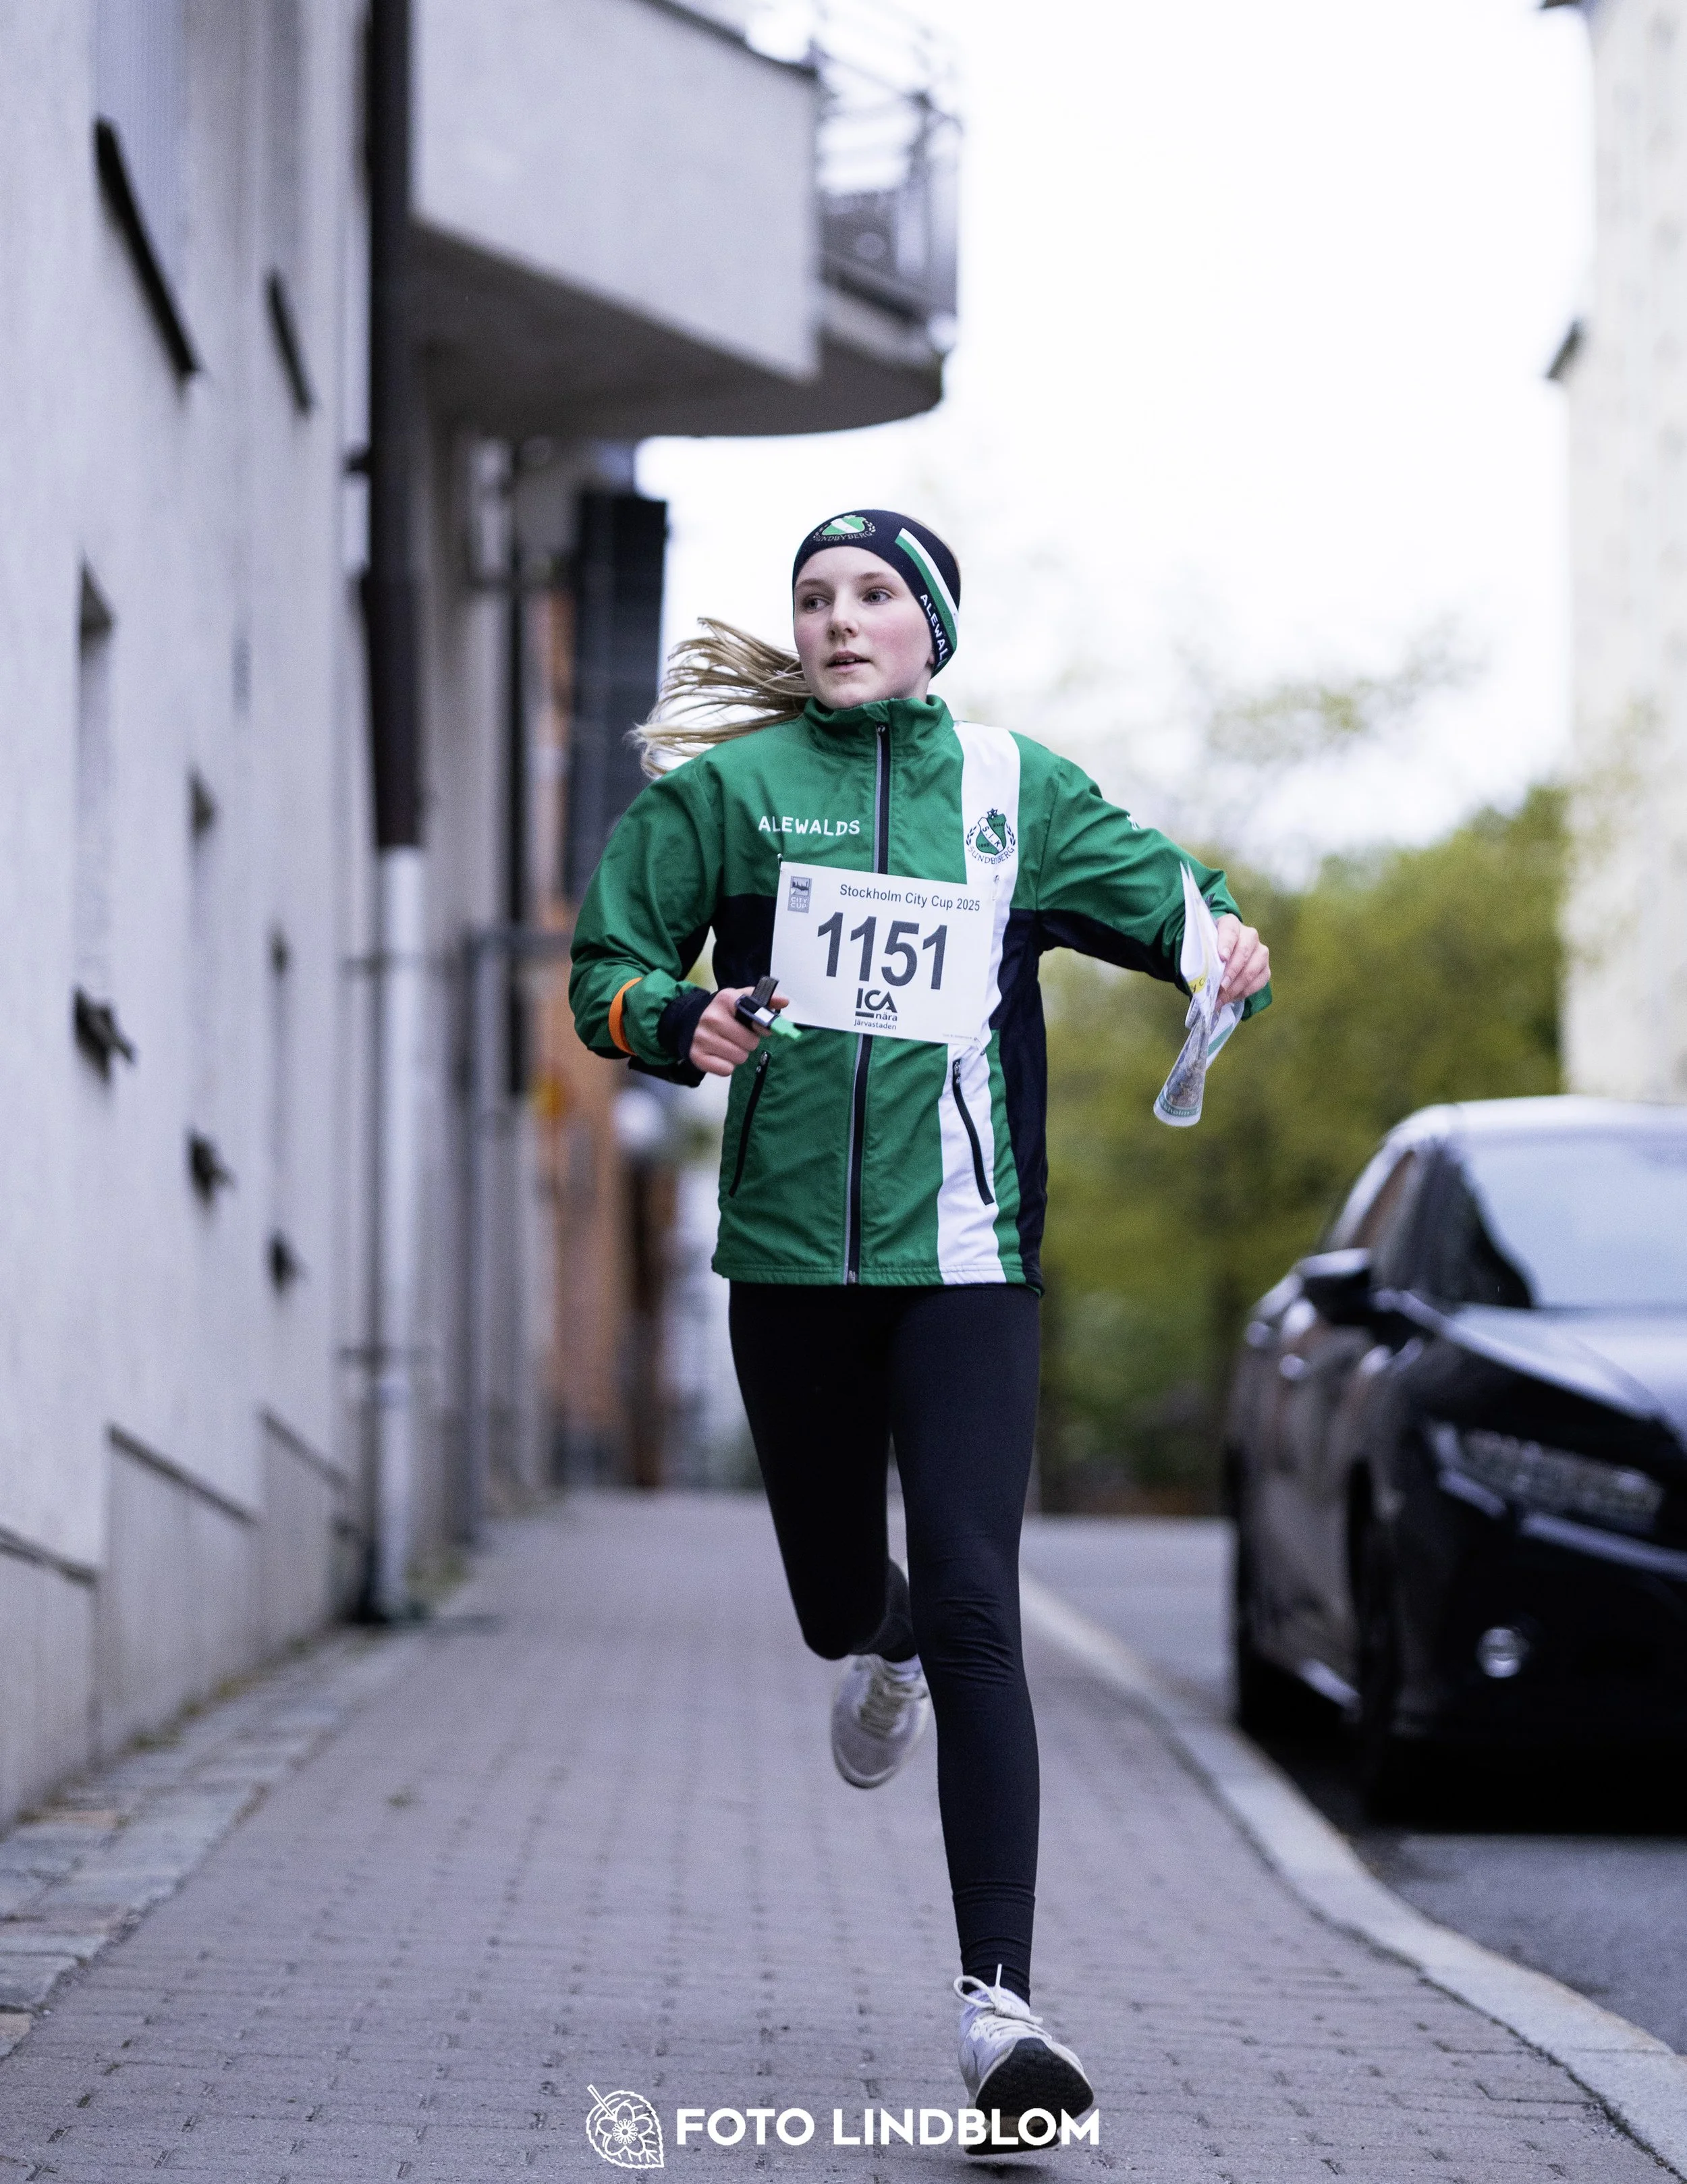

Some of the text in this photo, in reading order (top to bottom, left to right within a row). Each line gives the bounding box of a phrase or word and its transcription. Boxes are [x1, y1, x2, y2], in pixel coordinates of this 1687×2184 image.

[758, 815, 860, 836] ALEWALDS
[839, 883, 980, 911] Stockholm City Cup 2025
[817, 911, 948, 990] 1151
[856, 987, 898, 1014] ICA
[875, 1012, 898, 1022] nära
